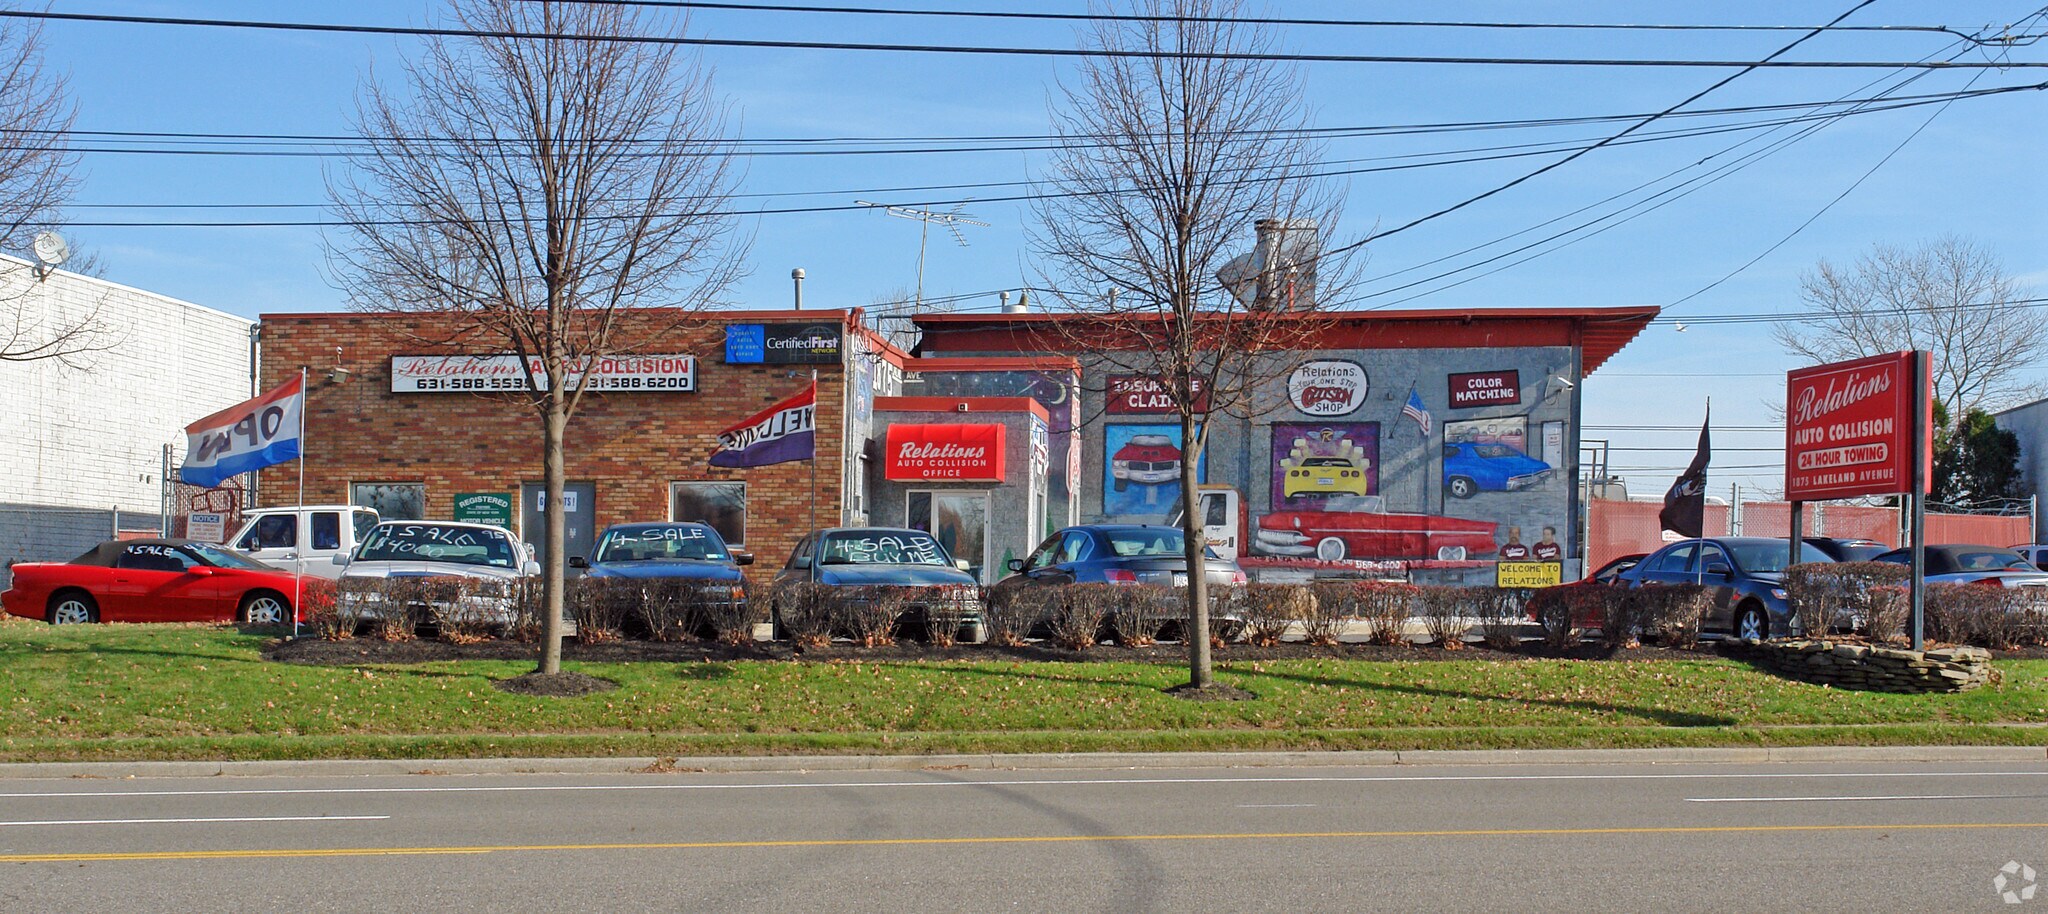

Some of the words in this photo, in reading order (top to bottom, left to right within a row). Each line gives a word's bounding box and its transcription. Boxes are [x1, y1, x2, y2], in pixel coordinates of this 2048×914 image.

[766, 336, 838, 349] CertifiedFirst
[397, 357, 518, 375] Relations
[582, 377, 689, 389] 31-588-6200
[1467, 377, 1503, 389] COLOR
[1455, 388, 1514, 402] MATCHING
[1794, 367, 1892, 426] Relations
[1314, 402, 1344, 412] SHOP
[1794, 426, 1824, 446] AUTO
[1828, 417, 1893, 442] COLLISION
[898, 441, 985, 459] Relations
[1800, 453, 1812, 467] 24
[1815, 450, 1841, 466] HOUR
[1844, 445, 1884, 463] TOWING
[897, 459, 924, 467] AUTO
[929, 459, 987, 467] COLLISION
[922, 469, 961, 477] OFFICE
[1792, 476, 1809, 487] 1875
[1812, 471, 1856, 486] LAKELAND
[1859, 468, 1894, 481] AVENUE
[458, 495, 509, 509] REGISTERED
[193, 515, 218, 523] NOTICE
[379, 525, 393, 537] 4
[399, 525, 477, 549] SALE
[611, 531, 638, 546] 4
[641, 528, 706, 547] SALE
[134, 545, 175, 557] SALE
[835, 539, 853, 553] 4
[860, 536, 935, 552] SALE
[849, 551, 901, 563] BUY
[1500, 564, 1541, 573] WELCOME
[1546, 565, 1559, 573] TO
[1502, 577, 1554, 585] RELATIONS
